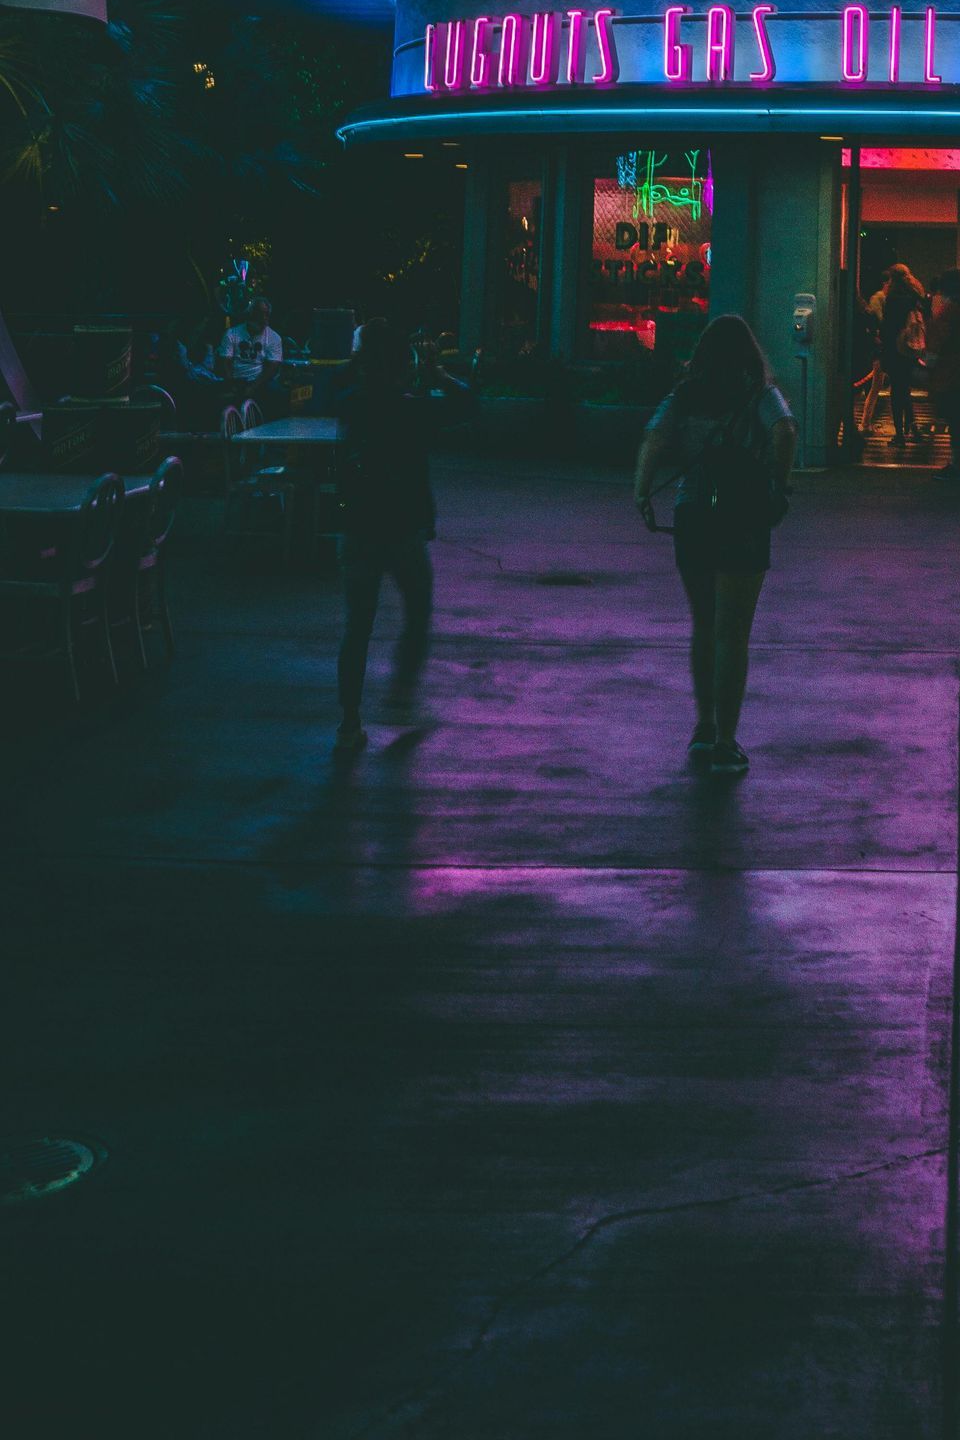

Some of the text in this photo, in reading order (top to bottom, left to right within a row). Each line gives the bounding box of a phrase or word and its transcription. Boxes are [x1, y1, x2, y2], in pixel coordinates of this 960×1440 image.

[423, 7, 619, 92] LUGNUTS
[662, 4, 776, 83] GAS
[841, 5, 942, 83] OIL
[615, 221, 667, 251] DIP
